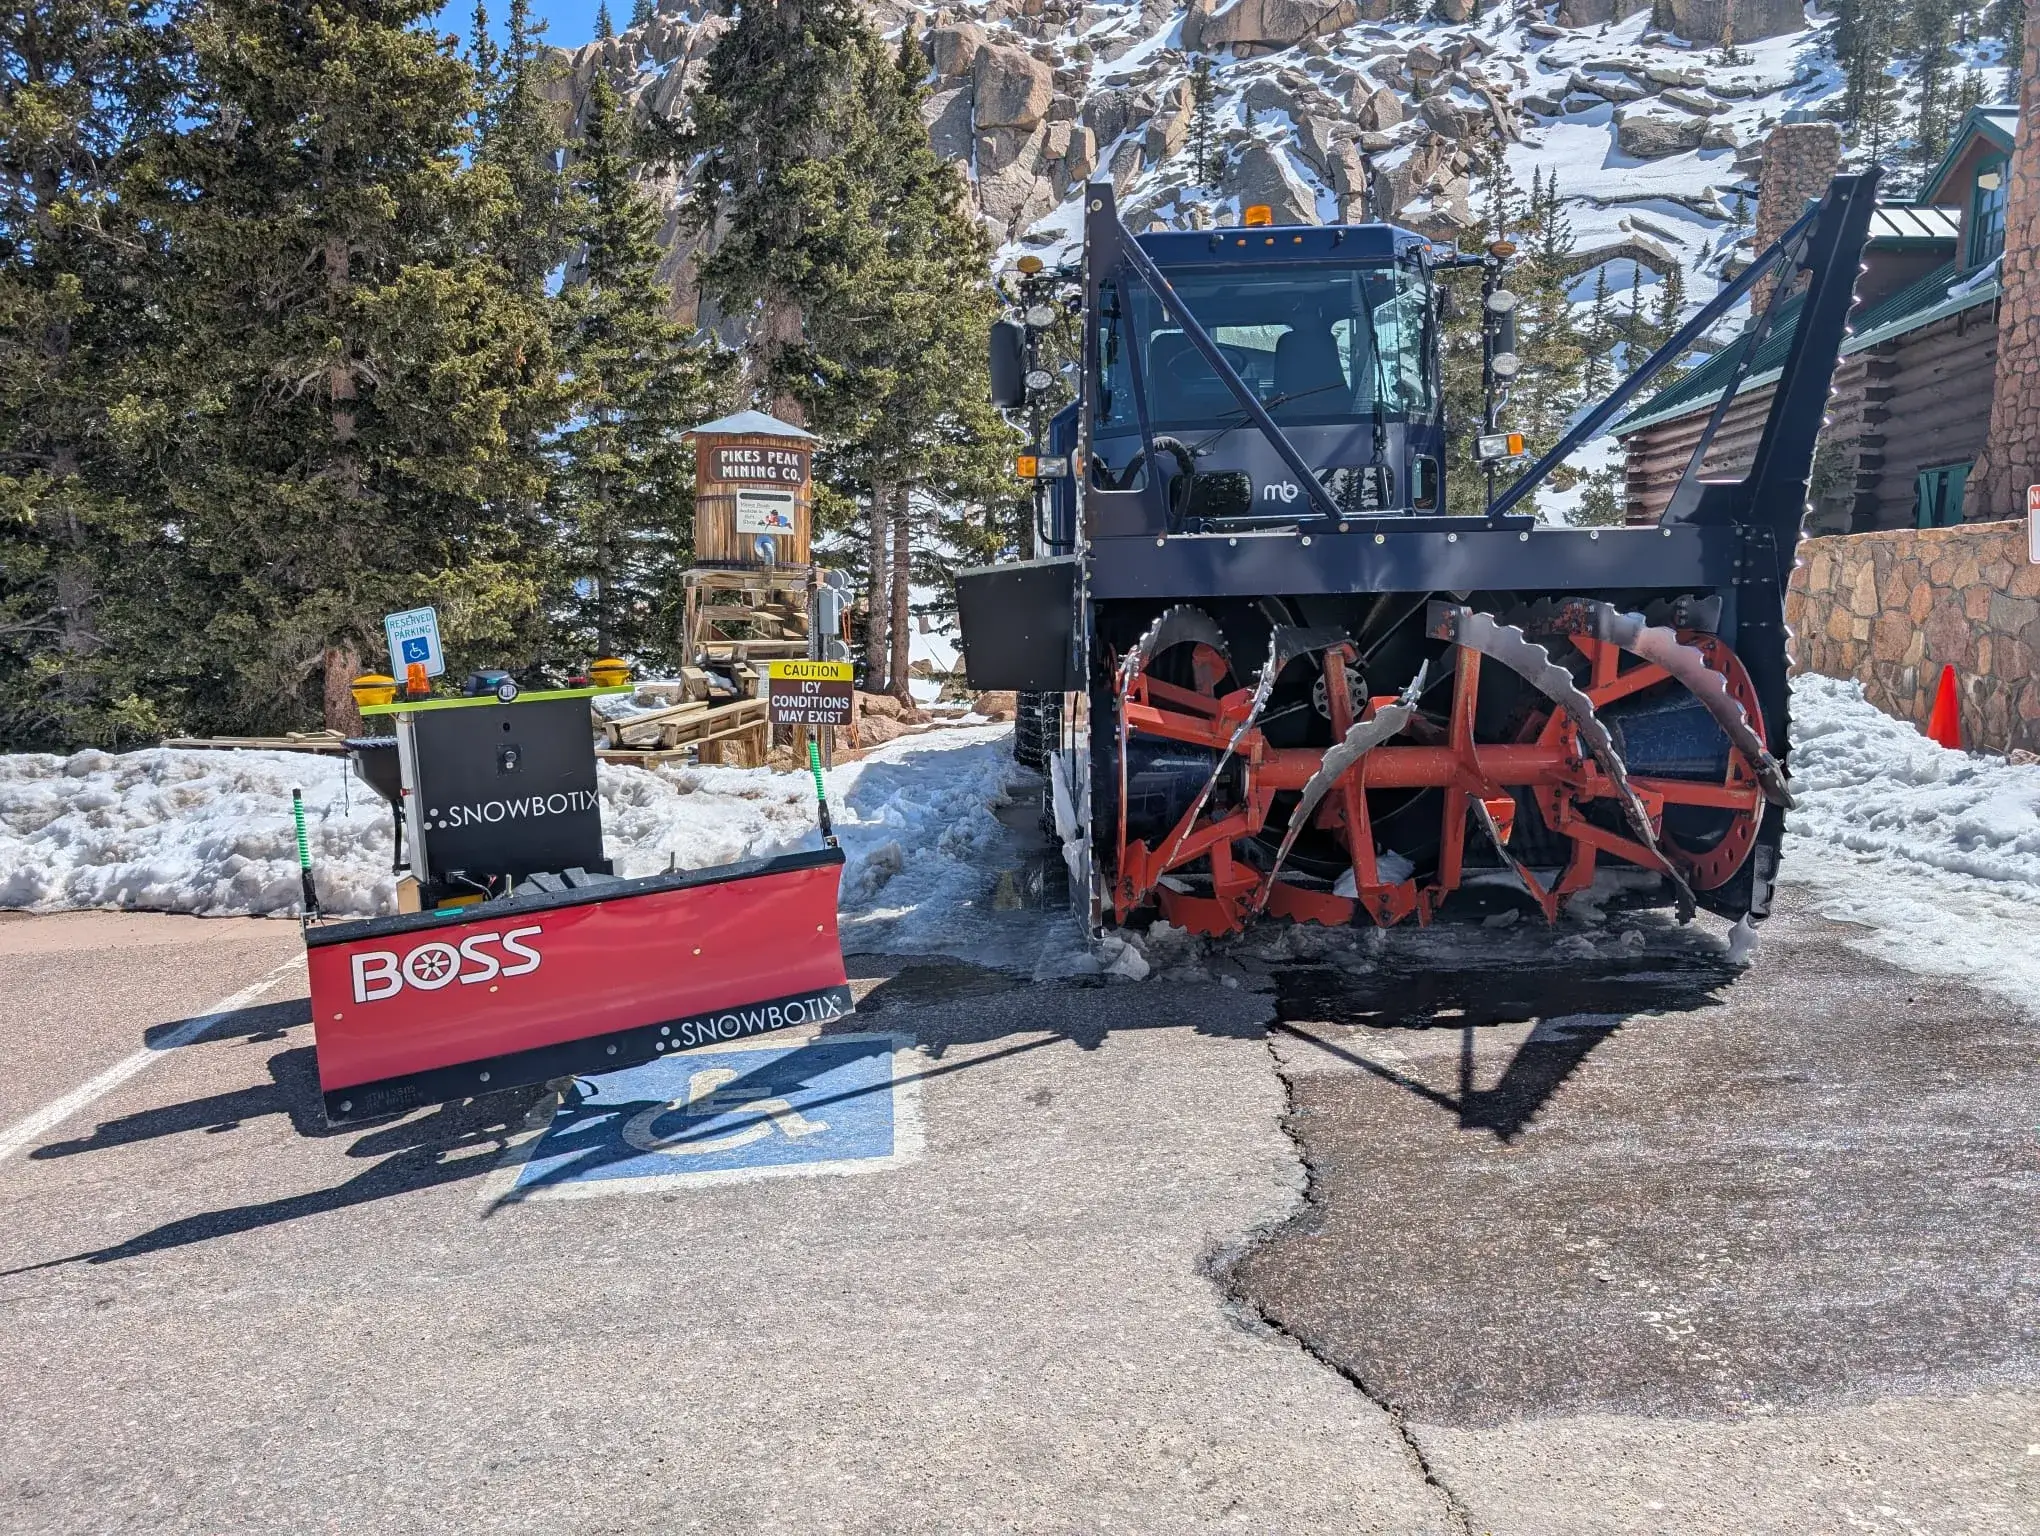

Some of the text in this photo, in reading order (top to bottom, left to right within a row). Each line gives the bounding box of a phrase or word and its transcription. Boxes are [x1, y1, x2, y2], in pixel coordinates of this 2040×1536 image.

[721, 450, 799, 466] PIKES PEAK
[722, 465, 801, 483] MINING CO.
[1263, 480, 1299, 504] mb
[2031, 490, 2040, 504] N
[389, 613, 432, 629] RESERVED
[394, 625, 432, 640] PARKING
[784, 664, 839, 677] CAUTION
[801, 681, 821, 694] ICY
[771, 695, 850, 709] CONDITIONS
[778, 710, 843, 724] MAY EXIST
[449, 789, 600, 828] SNOWBOTIX
[350, 924, 542, 1005] BOSS
[681, 993, 842, 1048] SNOWBOTIX
